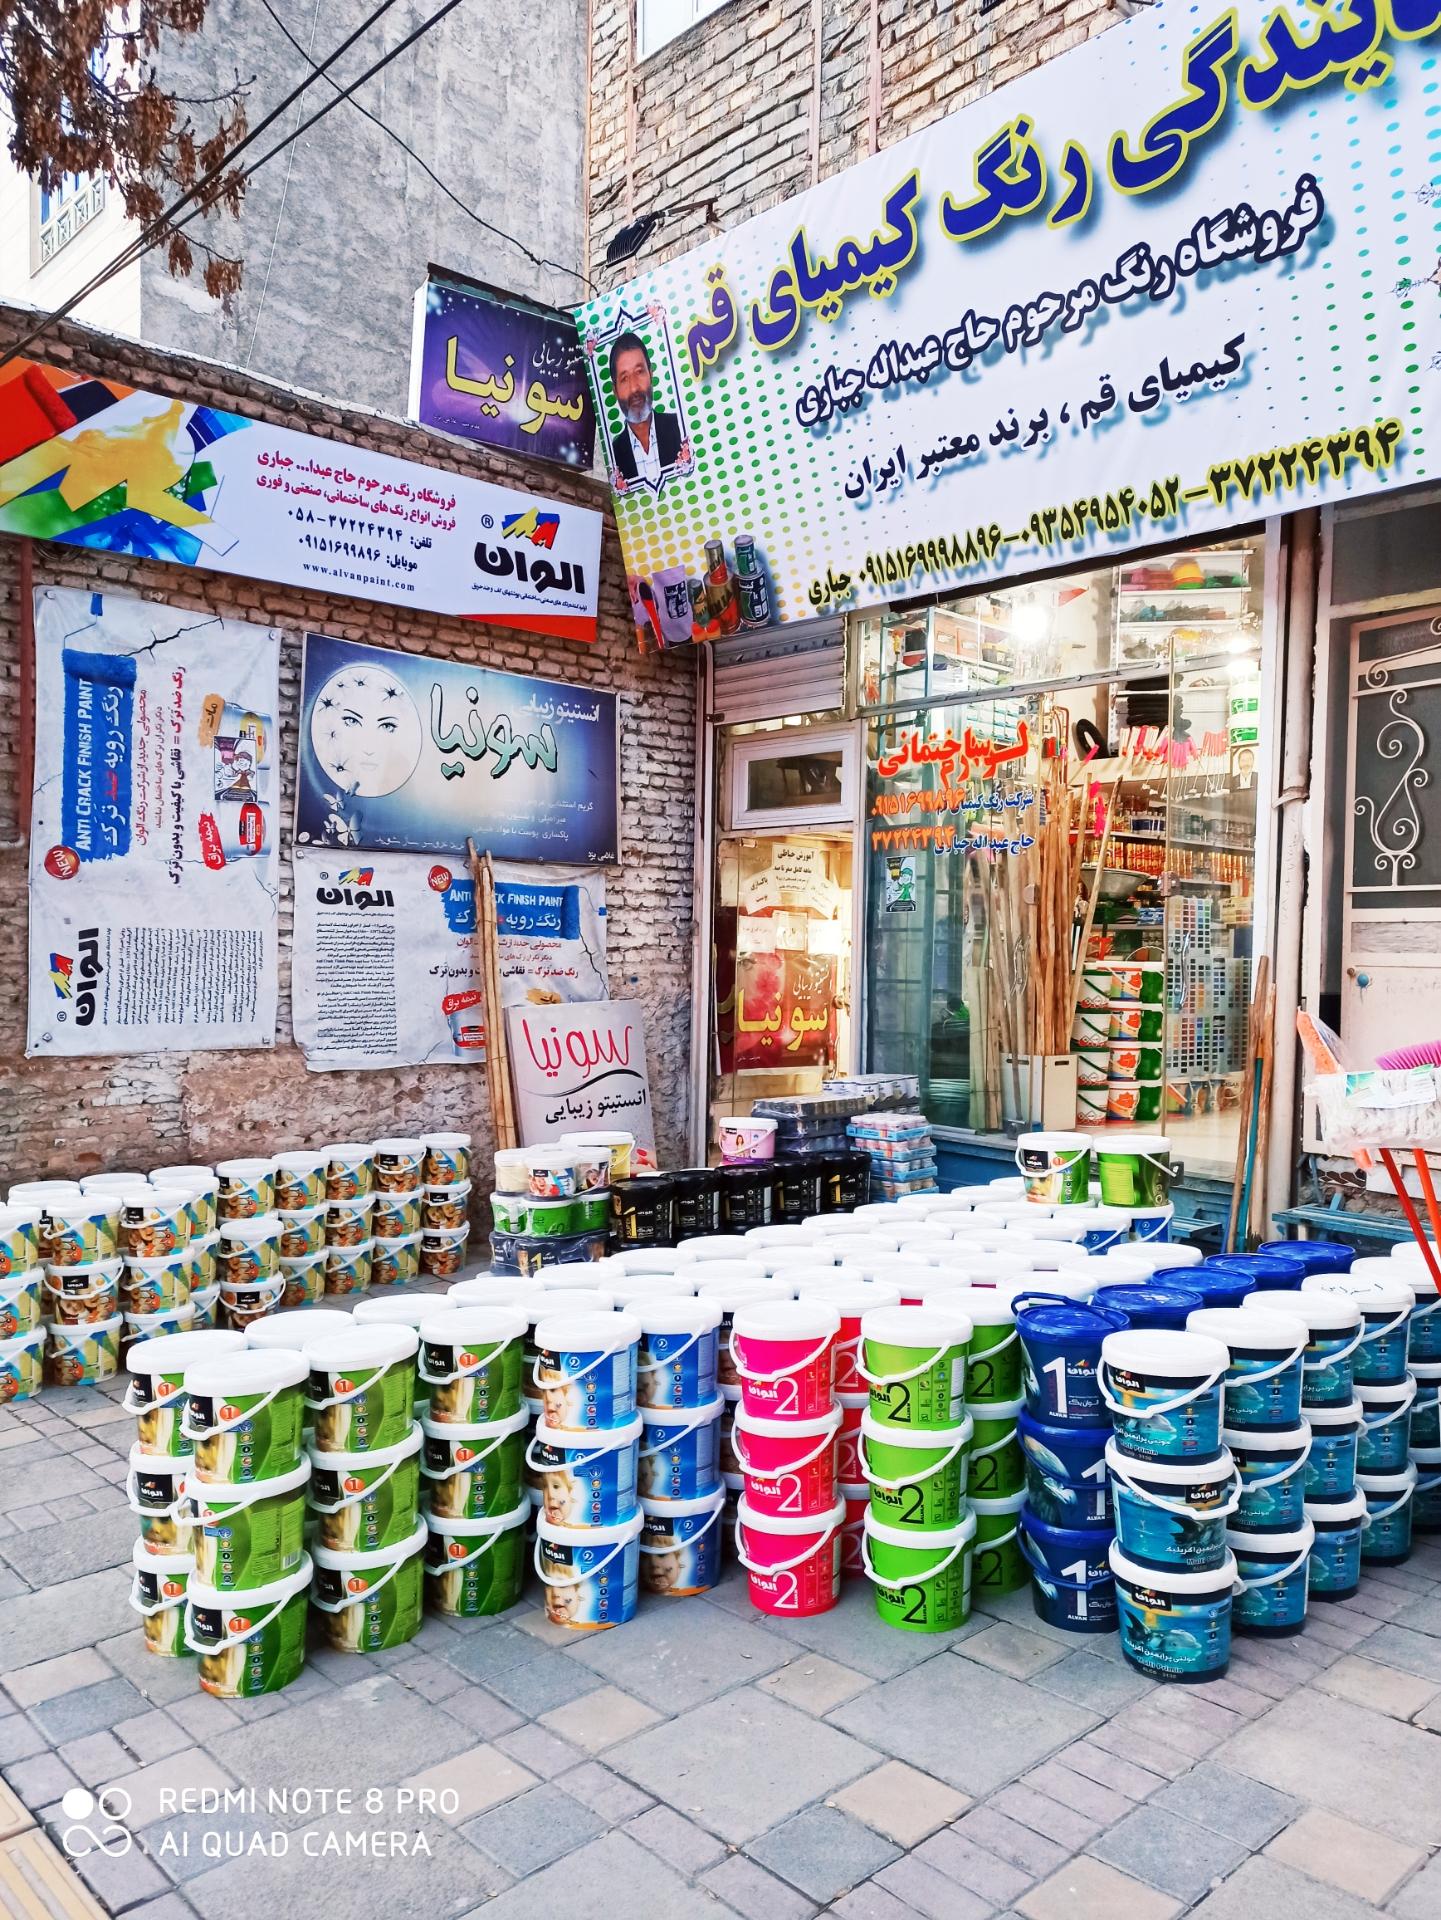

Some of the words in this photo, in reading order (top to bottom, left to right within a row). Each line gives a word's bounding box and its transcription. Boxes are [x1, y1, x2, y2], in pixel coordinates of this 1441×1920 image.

[939, 117, 1093, 242] رنگ
[1176, 173, 1324, 268] فروشگاه
[750, 168, 921, 352] کیمیای
[1101, 242, 1175, 304] رنگ
[686, 263, 737, 382] قم
[1003, 280, 1099, 352] مرحوم
[945, 309, 1000, 372] حاج
[867, 334, 944, 390] عبداله
[1129, 333, 1246, 413] کیمیای
[445, 335, 584, 435] سونیا
[797, 366, 867, 426] جباری
[1080, 373, 1116, 430] قم
[989, 403, 1048, 447] برند
[257, 451, 293, 471] جباری
[916, 432, 980, 480] معتبر
[257, 474, 283, 489] فوری
[334, 468, 355, 484] حاج
[358, 476, 392, 495] مرحوم
[845, 444, 906, 499] ایران
[285, 483, 289, 492] و
[292, 482, 321, 496] صنعتی
[394, 483, 415, 501] رنگ
[417, 489, 456, 511] فروشگاه
[371, 501, 388, 513] های
[390, 504, 408, 520] رنگ
[409, 511, 430, 524] انواع
[431, 516, 456, 530] فروش
[299, 534, 381, 561] ۰۹۱۵۱۶۹۹۸۹۶
[410, 536, 432, 549] تلفن:
[303, 562, 415, 591] www.alvanpaint.com
[386, 555, 418, 572] موبایل:
[474, 542, 585, 594] الوان
[808, 567, 852, 606] جباری
[171, 666, 185, 689] رنگ
[77, 678, 93, 719] PAINT
[100, 686, 124, 726] رنگ
[137, 690, 150, 736] محصولی
[556, 702, 600, 724] انستیتو
[78, 723, 92, 766] FINISH
[430, 683, 557, 780] سونیا
[102, 731, 125, 768] رویه
[138, 737, 149, 762] جدید
[170, 748, 185, 780] نقاشی
[75, 769, 92, 815] CRACK
[103, 770, 118, 800] ضد
[137, 771, 150, 800] شرکت
[170, 781, 183, 789] با
[137, 801, 148, 822] رنگ
[170, 791, 182, 822] کیفیت
[75, 819, 92, 851] ANTI
[136, 823, 148, 846] الوان
[170, 833, 184, 859] بدون
[202, 821, 217, 844] نیمه
[52, 850, 73, 876] NEW
[206, 845, 222, 865] براق
[431, 871, 449, 886] NEW
[316, 887, 395, 910] الوان
[450, 889, 471, 901] ANTI
[507, 893, 536, 905] FINISH
[539, 895, 563, 906] PAINT
[506, 913, 533, 930] رویه
[536, 914, 562, 930] رنگ
[75, 928, 103, 1026] الوان
[449, 966, 468, 978] بدون
[503, 966, 525, 977] نقاشی
[565, 968, 578, 978] رنگ
[738, 988, 828, 1051] سونیا
[522, 1019, 632, 1078] سونیا
[546, 1098, 592, 1123] زیبایی
[598, 1089, 646, 1117] انستیتو
[773, 1377, 799, 1414] 2
[1042, 1357, 1067, 1414] 1
[887, 1382, 911, 1422] 2
[776, 1474, 802, 1511] 2
[1081, 1459, 1106, 1515] 1
[1191, 1489, 1217, 1500] الوان
[898, 1484, 924, 1524] 2
[773, 1570, 798, 1608] 2
[1061, 1560, 1087, 1616] 1
[900, 1585, 927, 1624] 2
